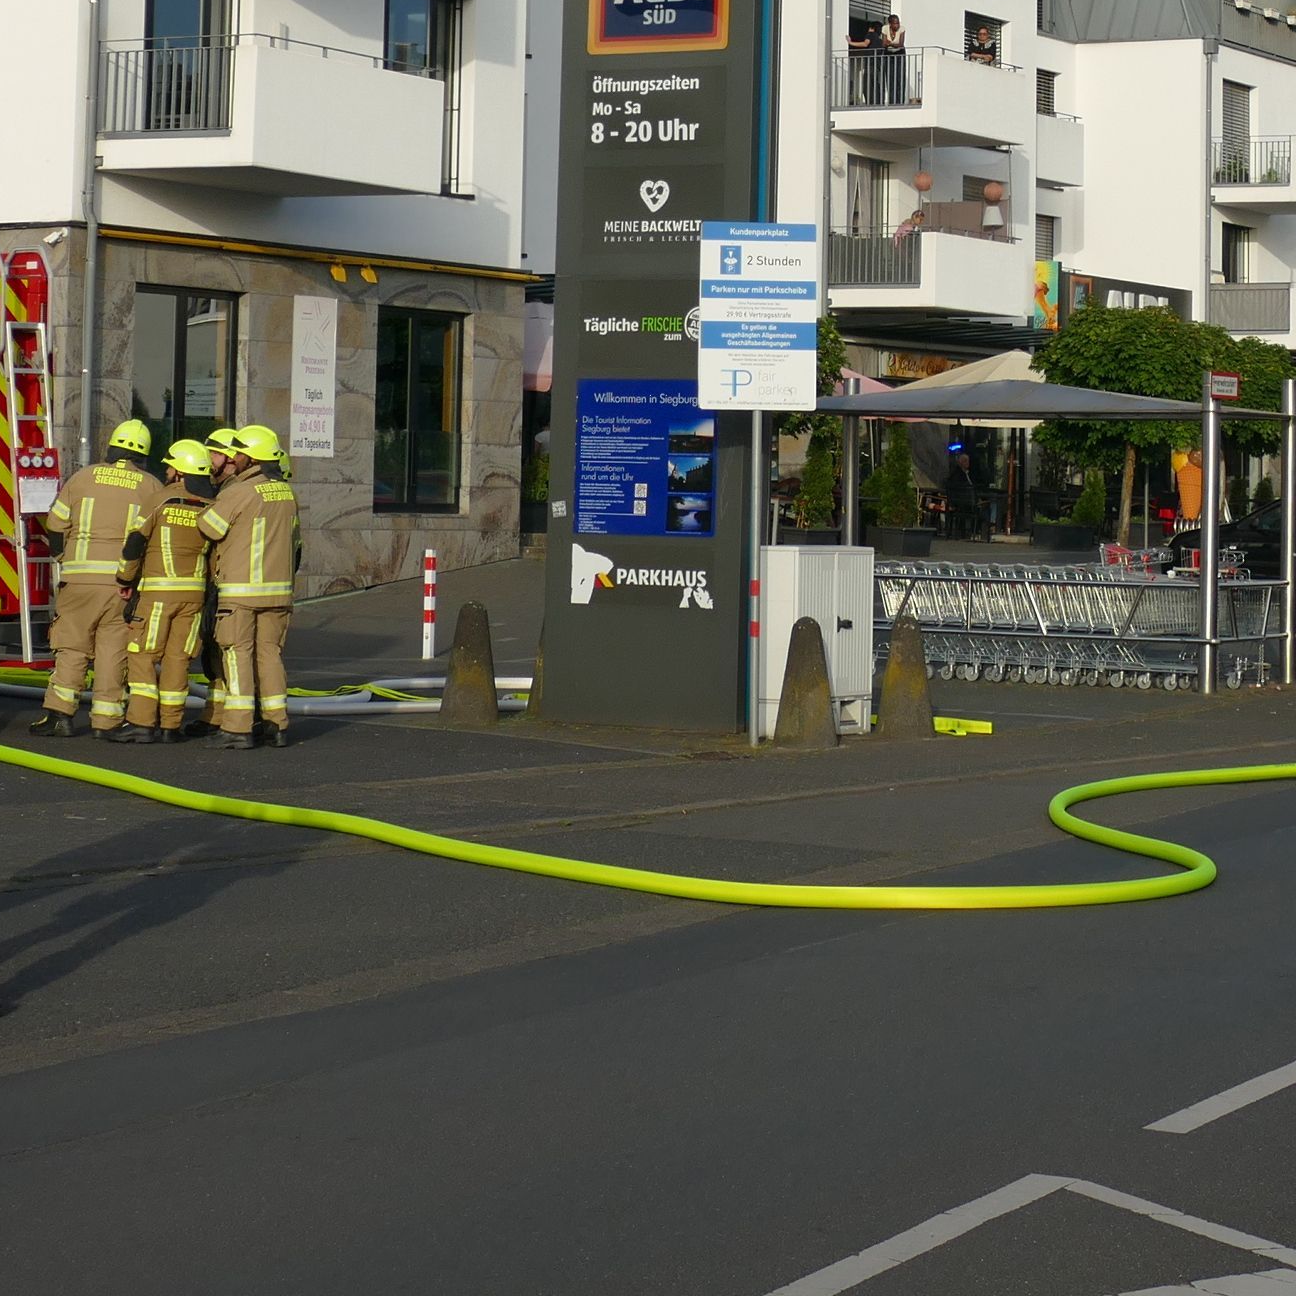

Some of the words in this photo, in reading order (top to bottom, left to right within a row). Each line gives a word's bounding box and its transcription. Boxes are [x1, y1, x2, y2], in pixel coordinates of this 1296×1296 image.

[643, 5, 676, 25] SÜD
[593, 75, 699, 95] Öffnungszeiten
[593, 102, 612, 116] Mo
[624, 101, 641, 116] Sa
[591, 122, 604, 144] 8
[625, 121, 652, 142] 20
[658, 119, 699, 142] Uhr
[604, 220, 639, 233] MEINE
[641, 220, 701, 232] BACKWELT
[730, 227, 789, 237] Kundenparkplatz
[747, 255, 753, 266] 2
[756, 255, 802, 266] Stunden
[711, 285, 736, 294] Parken
[751, 286, 763, 294] mit
[764, 286, 807, 295] Parkscheibe
[584, 317, 639, 335] Tägliche
[641, 317, 683, 332] FRISCHE
[664, 333, 682, 341] zum
[758, 370, 776, 382] fair
[304, 388, 323, 403] Täglich
[758, 384, 797, 397] parken
[594, 392, 646, 404] Willkommen
[649, 394, 657, 404] in
[659, 392, 699, 407] Siegburg
[582, 416, 593, 424] Die
[615, 416, 652, 424] Information
[582, 424, 611, 435] Siegburg
[93, 466, 144, 483] FEUERWEHR
[95, 475, 138, 490] SIEGBURG
[162, 507, 199, 519] FEUER
[166, 515, 197, 528] SIEGB
[616, 568, 707, 588] PARKHAUS
